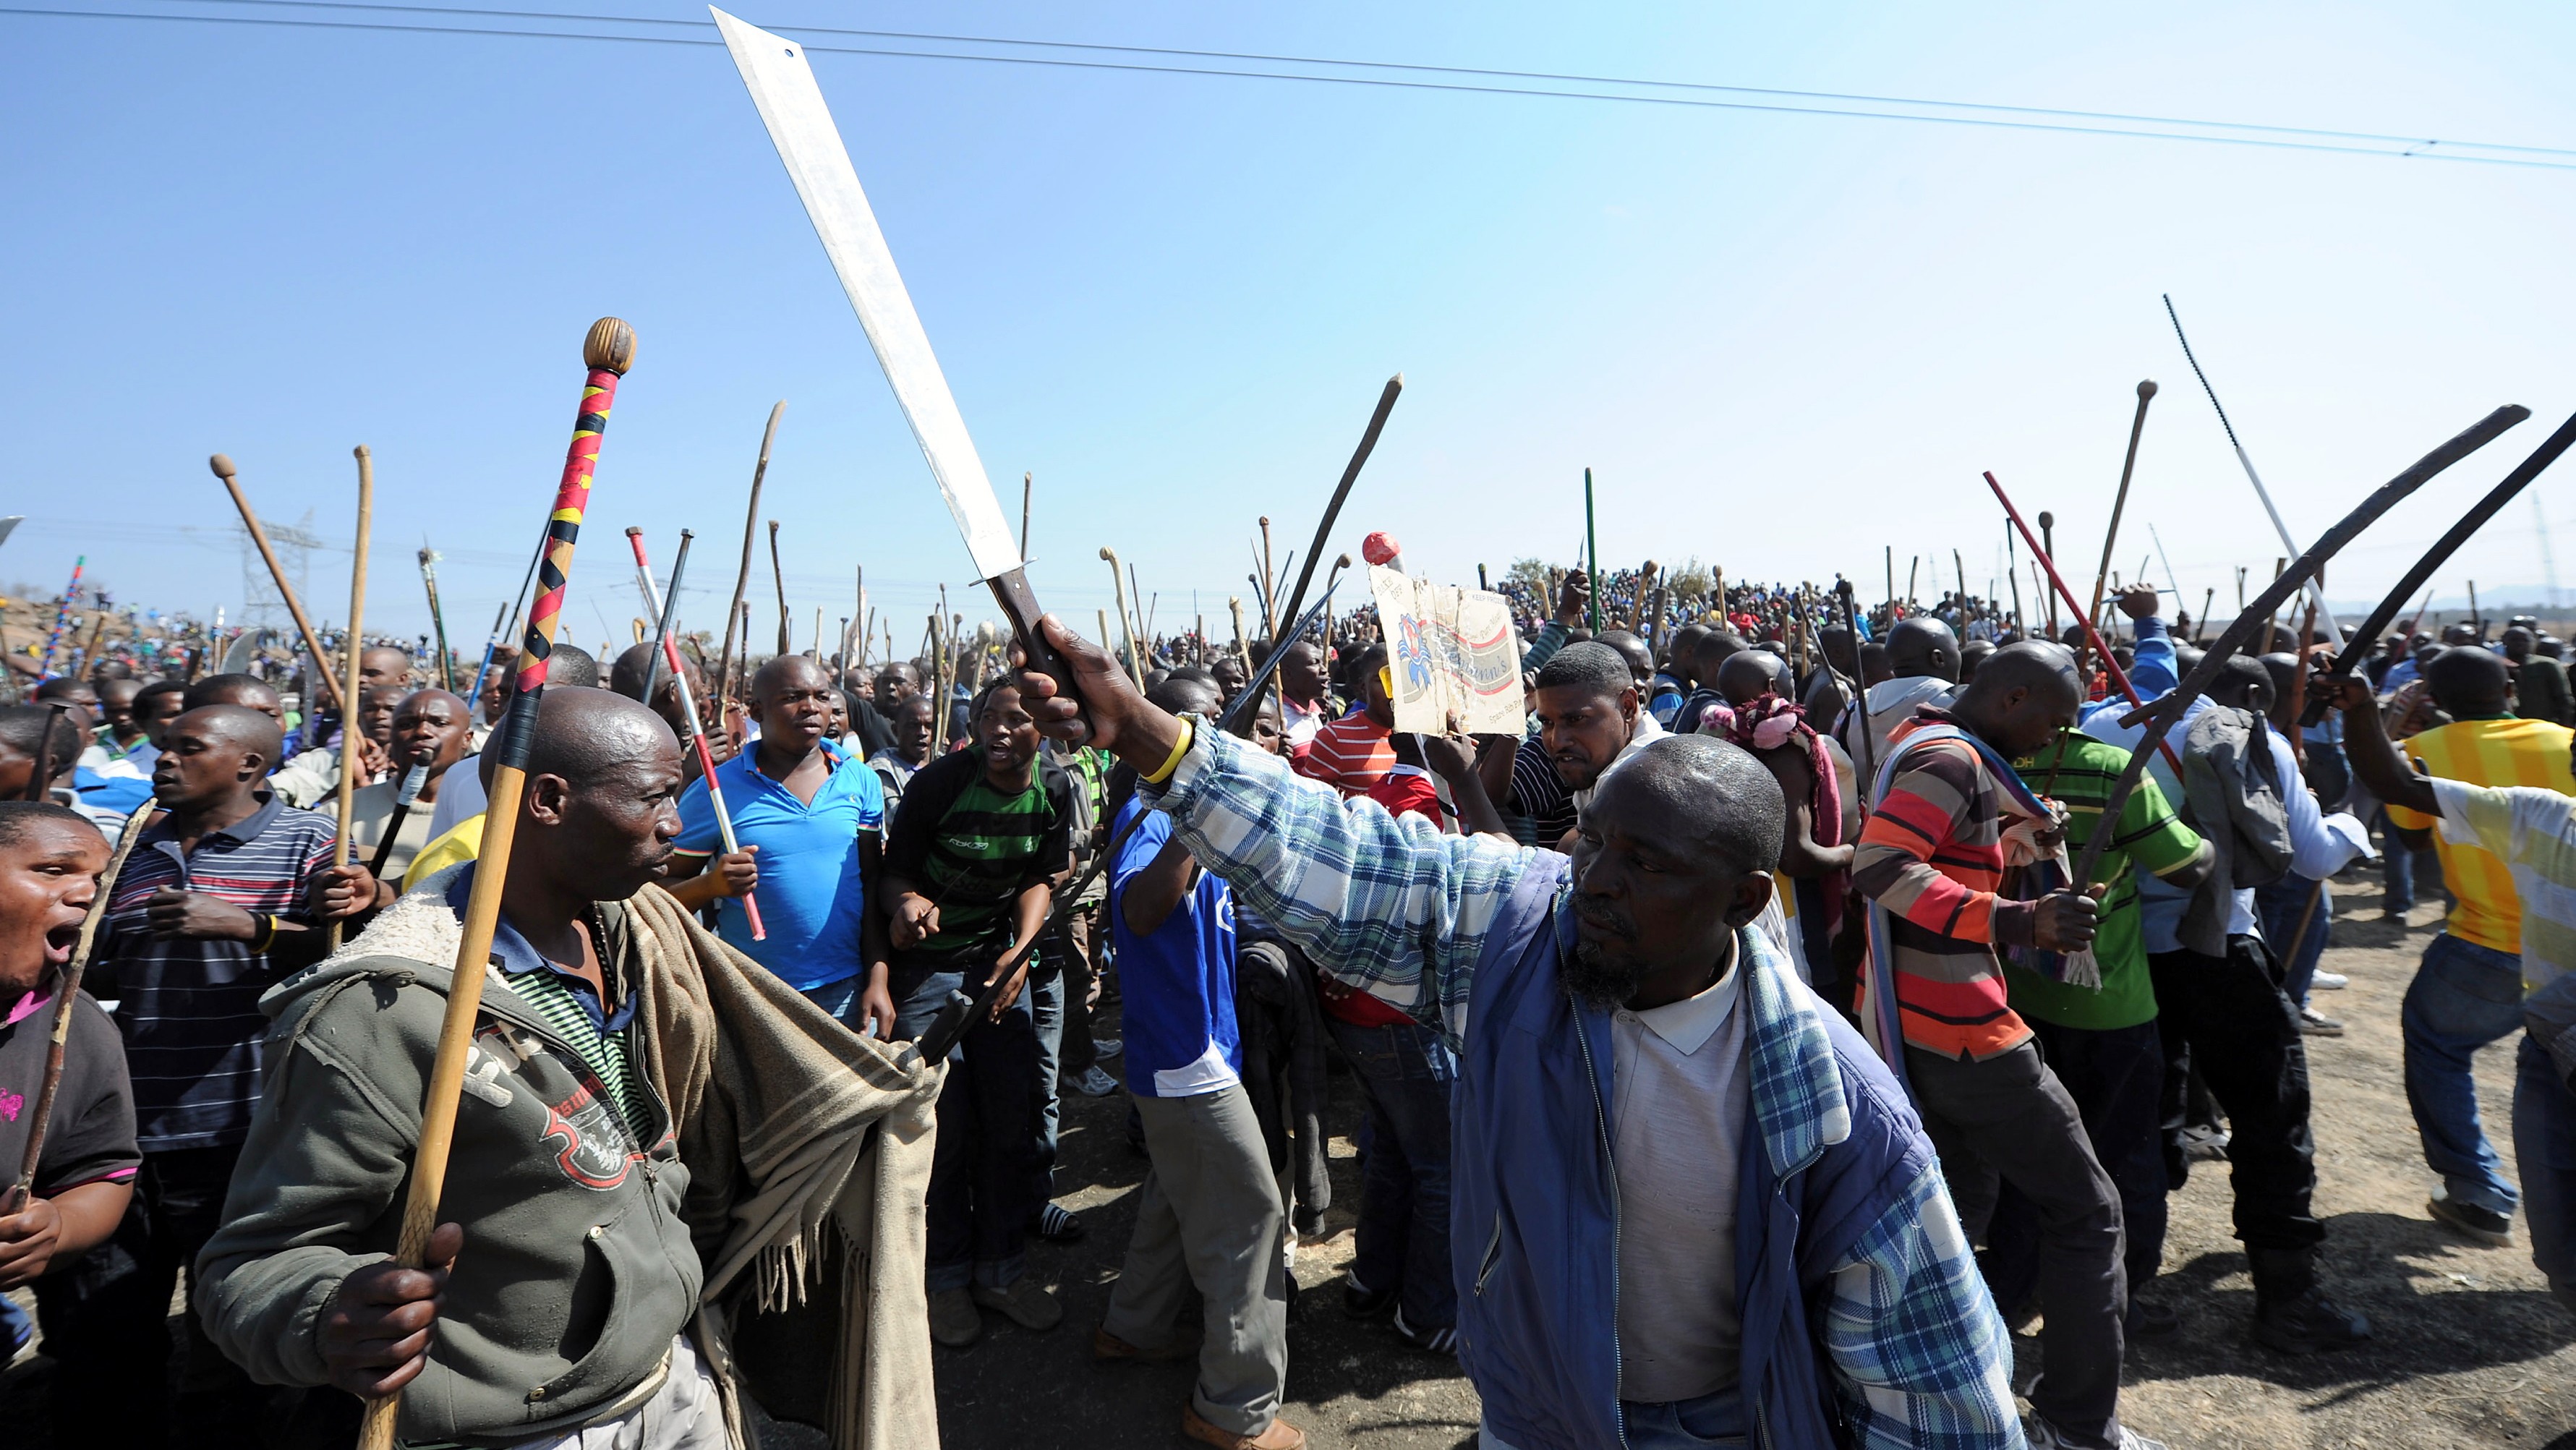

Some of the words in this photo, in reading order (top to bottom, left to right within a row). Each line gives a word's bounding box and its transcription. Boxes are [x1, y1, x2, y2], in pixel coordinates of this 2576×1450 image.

[1391, 584, 1403, 600] OFF
[1486, 596, 1505, 605] FROZEN
[1489, 710, 1505, 724] Spare
[1504, 704, 1514, 715] Rib
